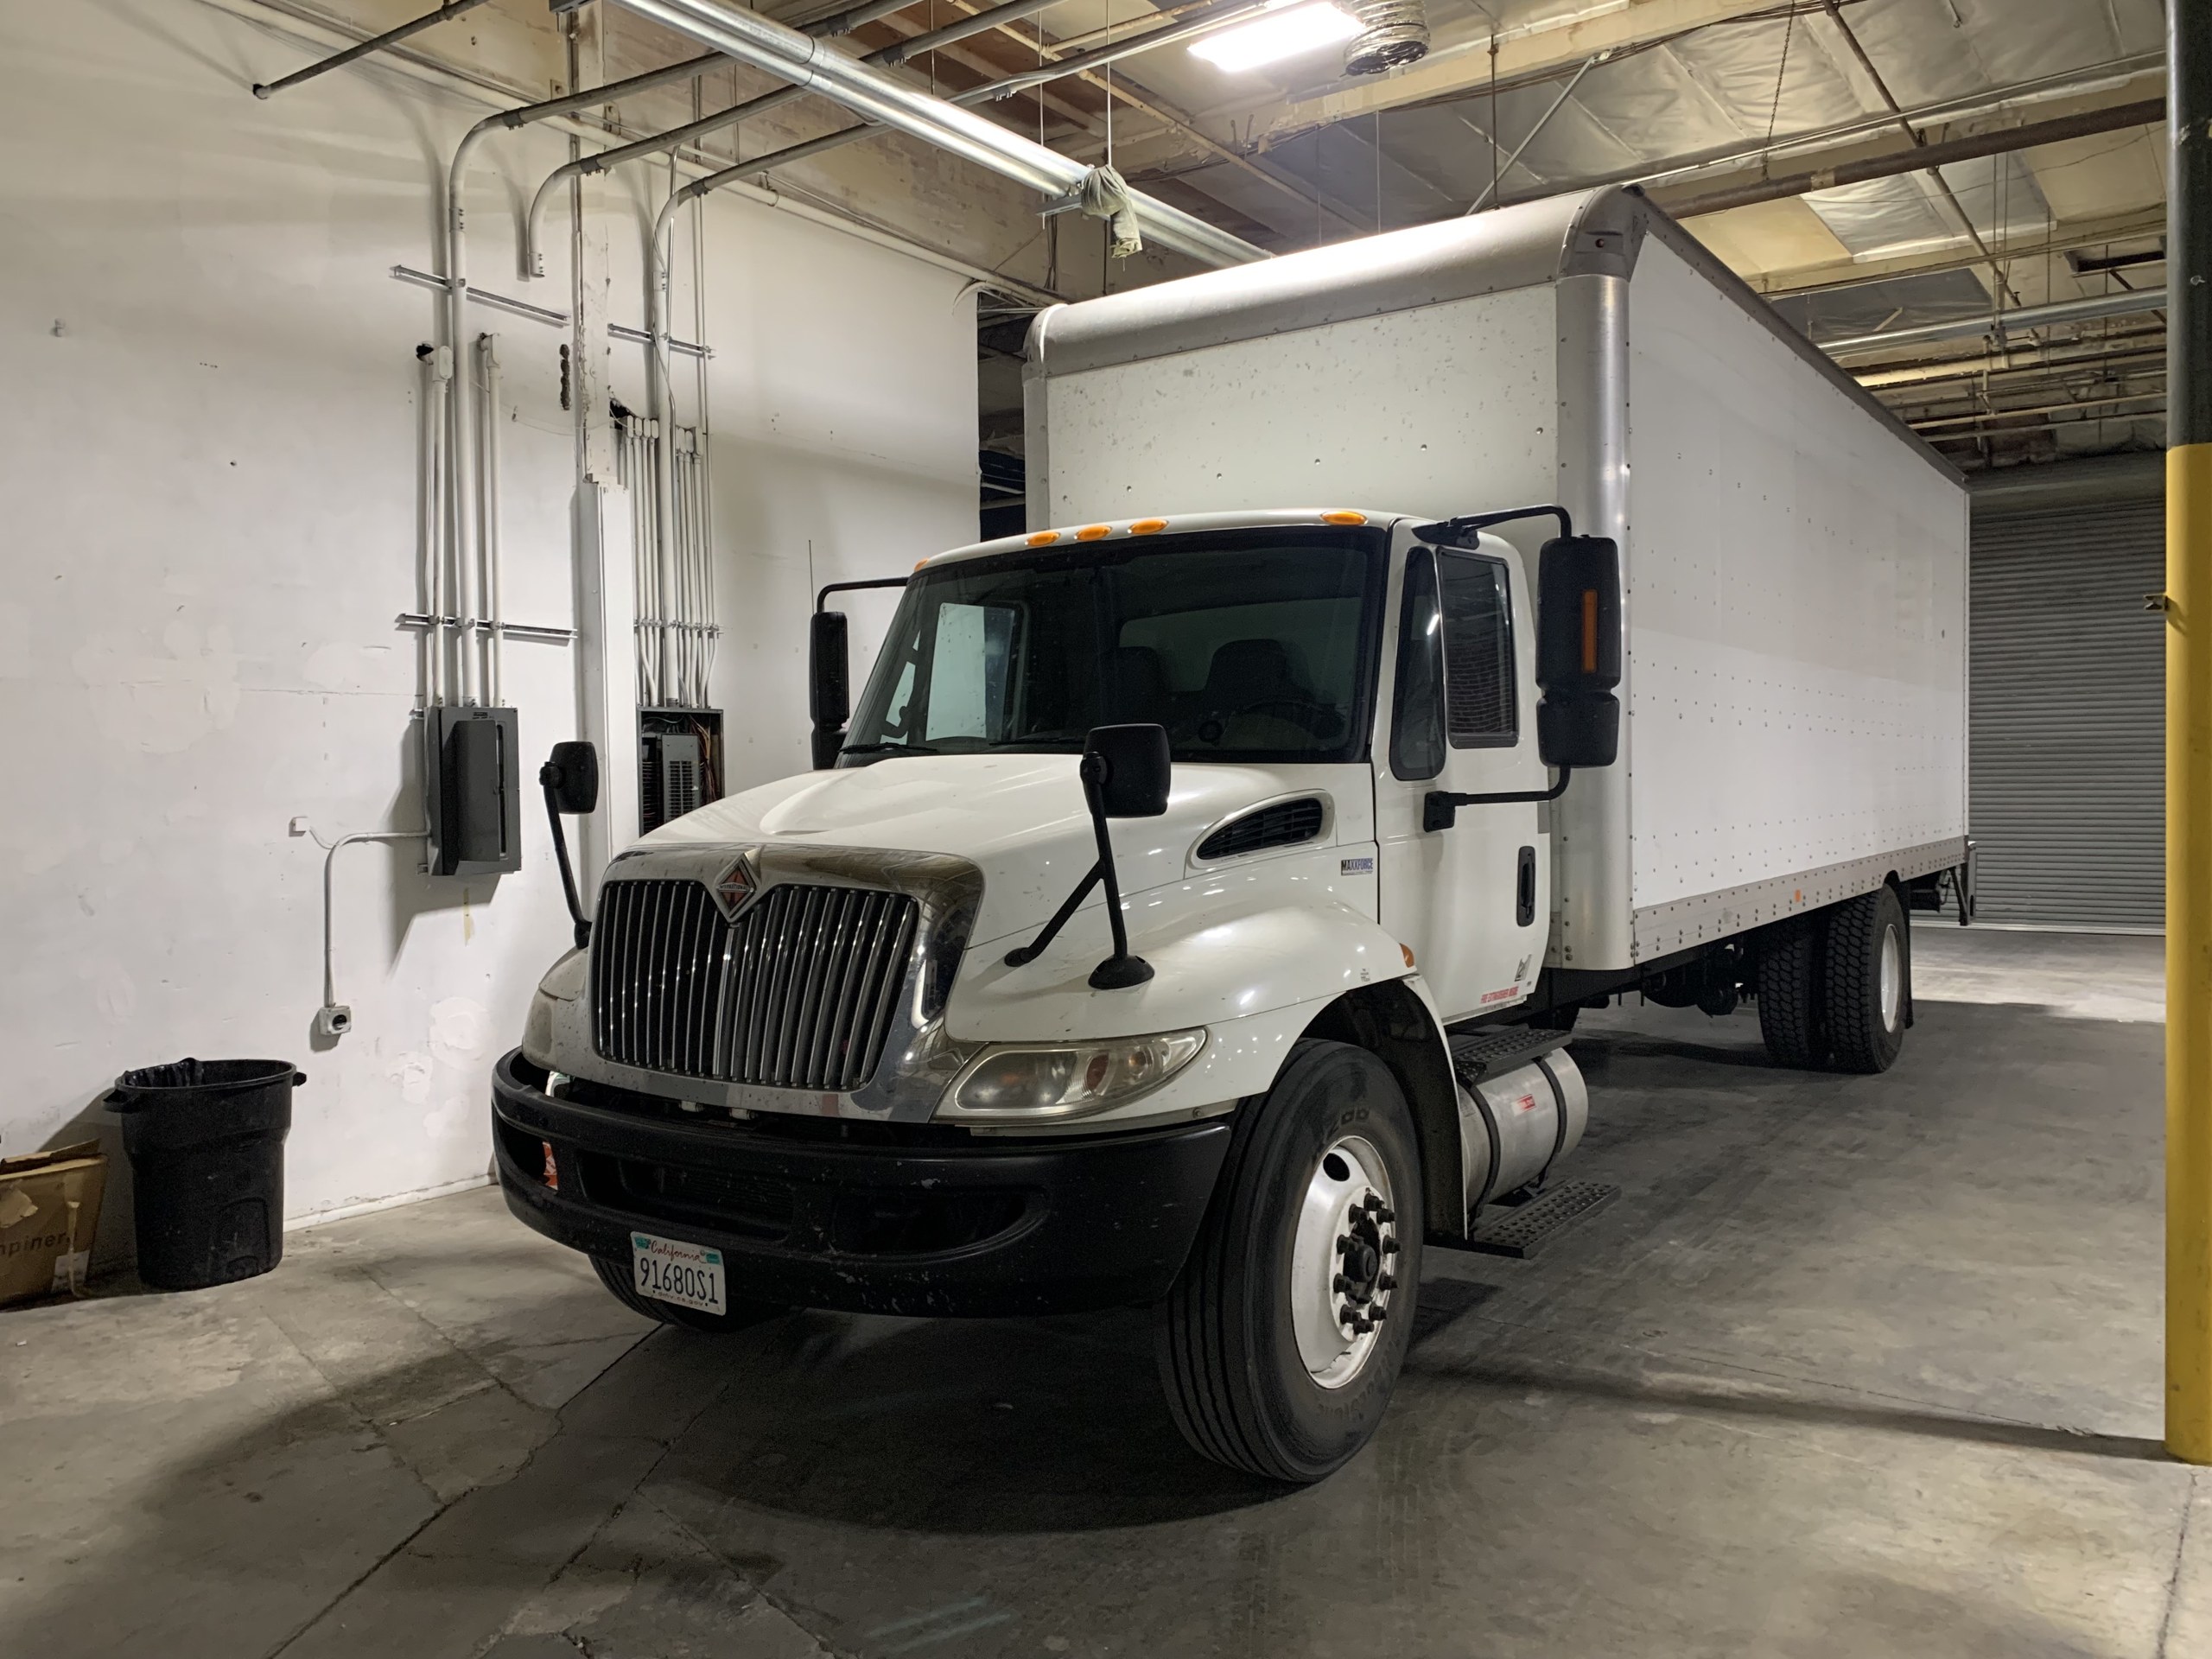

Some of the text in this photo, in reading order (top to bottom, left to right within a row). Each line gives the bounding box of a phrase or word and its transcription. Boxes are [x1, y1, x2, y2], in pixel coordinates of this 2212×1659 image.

[1341, 858, 1374, 871] MAXXFORCE
[651, 1240, 707, 1264] California
[640, 1257, 719, 1305] 91680S1
